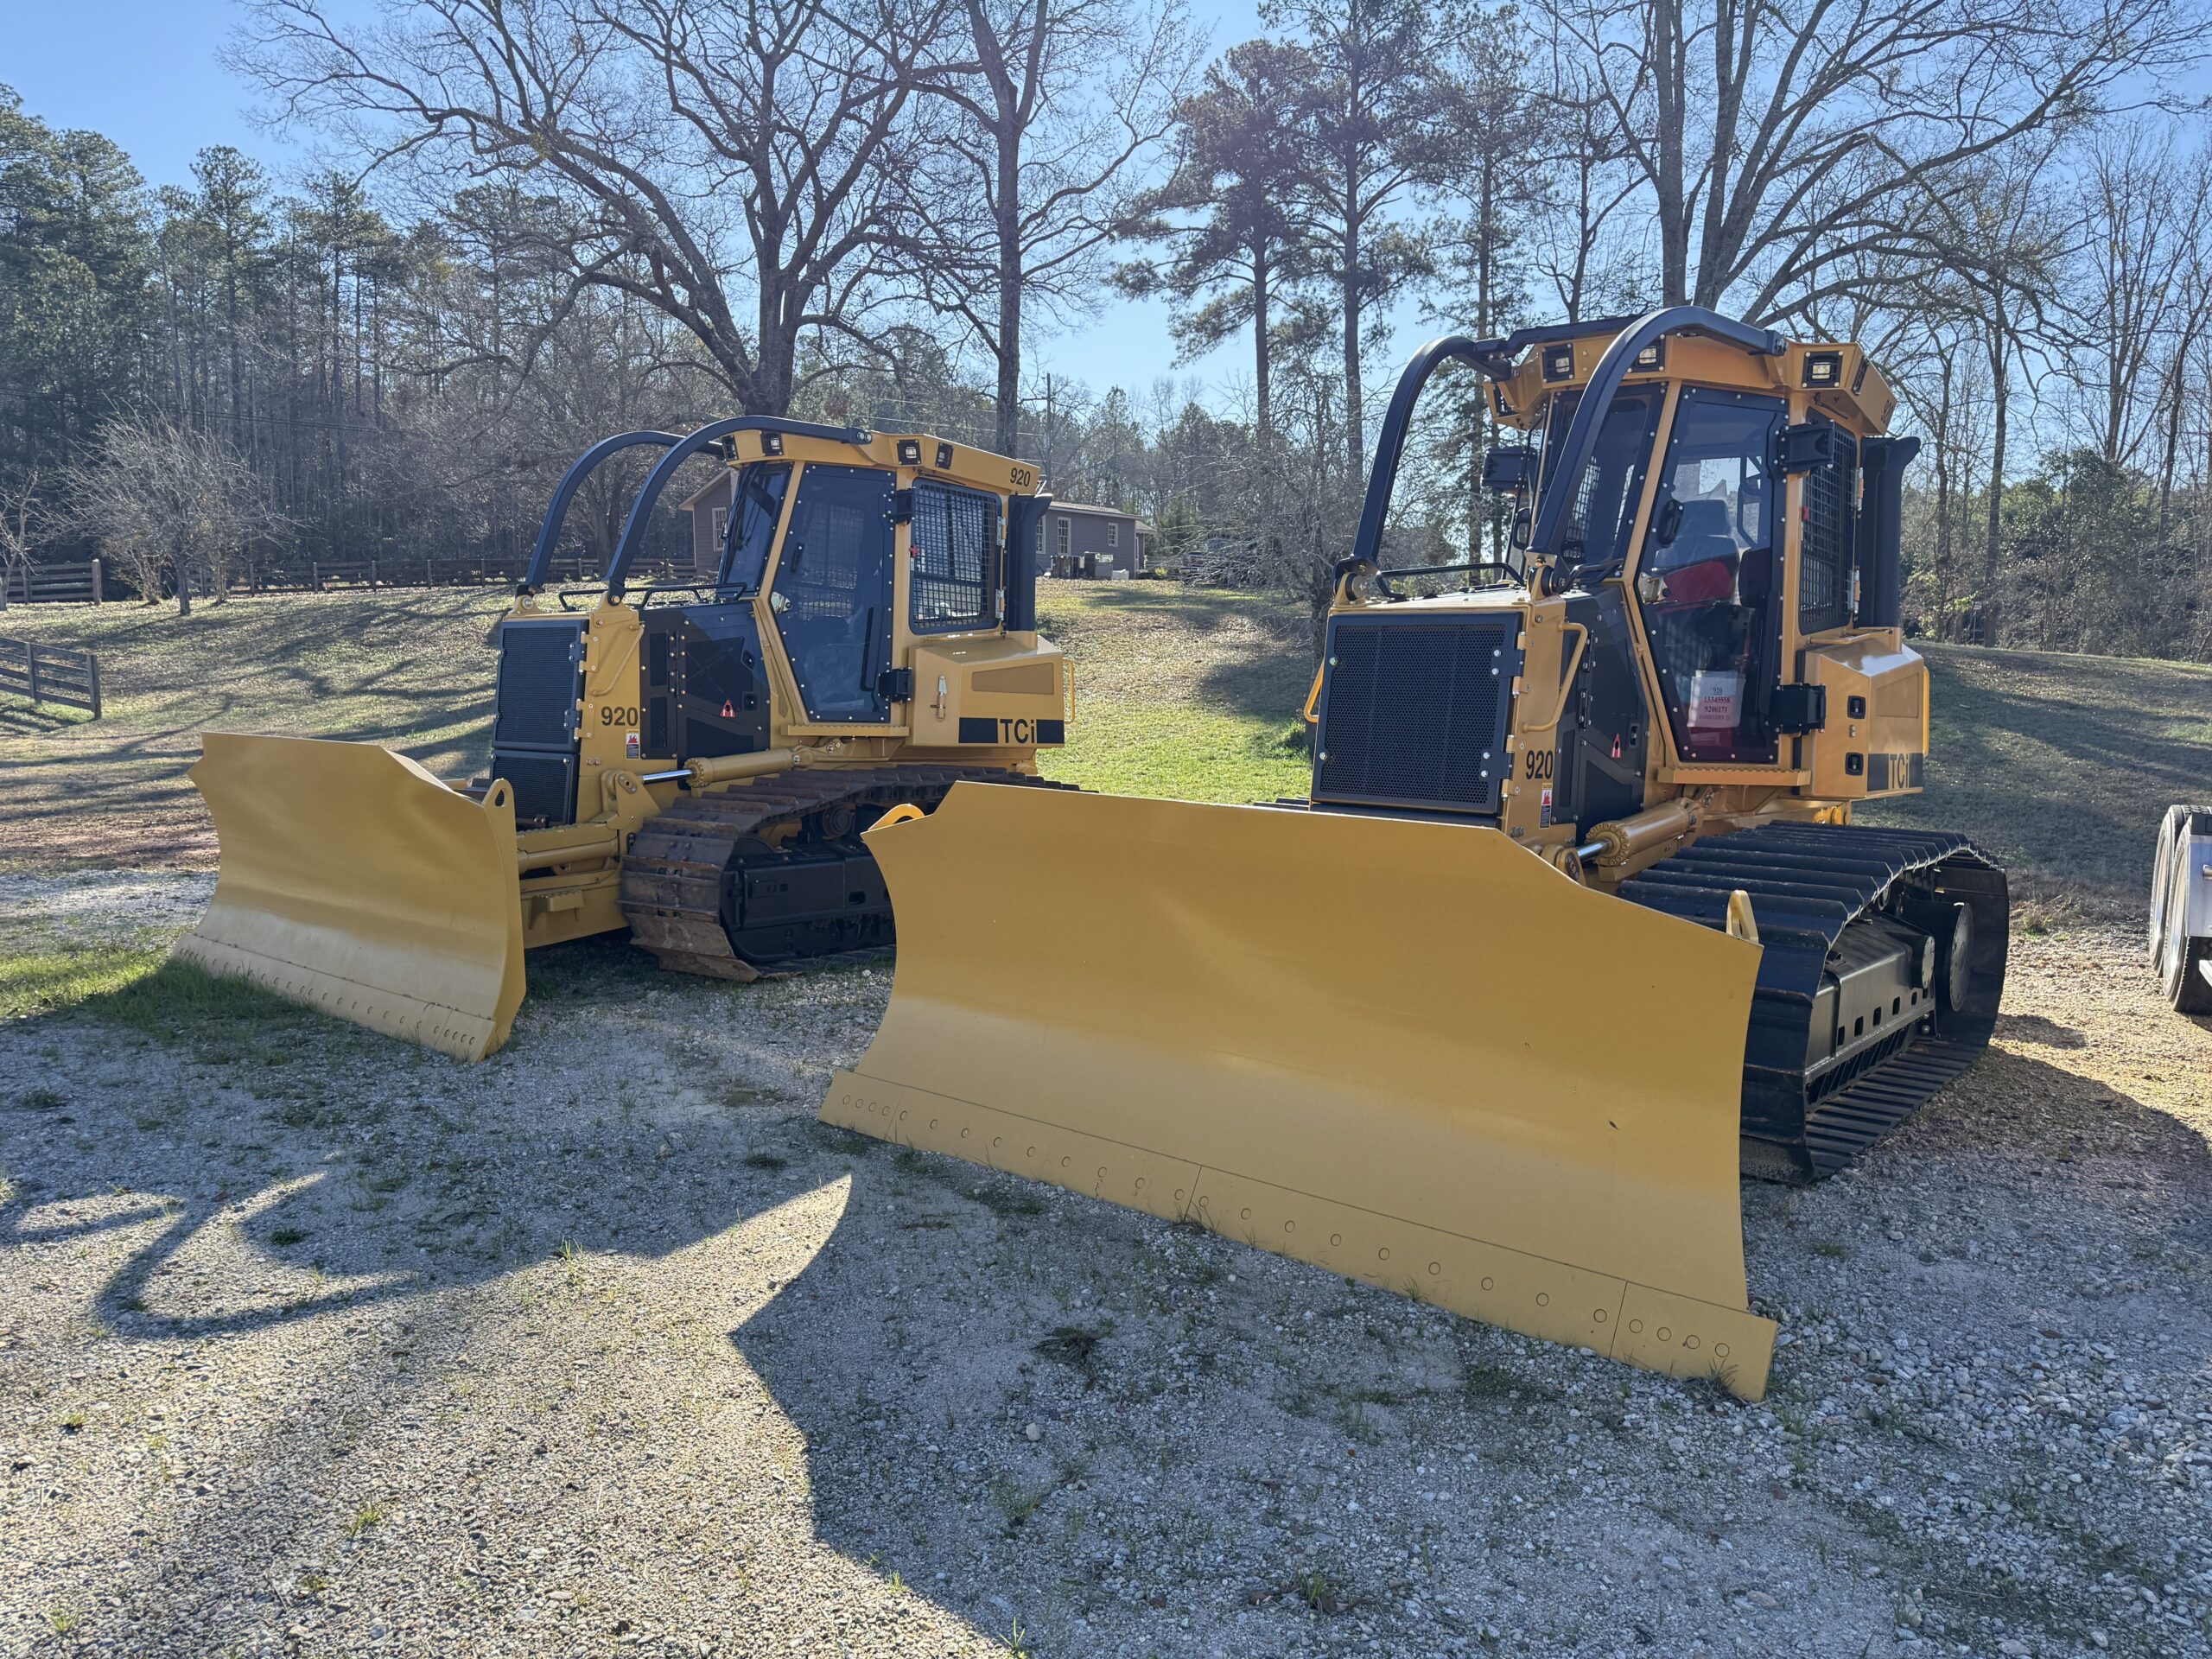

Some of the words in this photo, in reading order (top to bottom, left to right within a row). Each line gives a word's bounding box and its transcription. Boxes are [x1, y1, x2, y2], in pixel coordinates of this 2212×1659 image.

[1010, 467, 1031, 487] 920
[601, 706, 639, 727] 920
[1000, 719, 1035, 744] TCi
[1526, 750, 1554, 779] 920
[1890, 753, 1908, 789] TCi
